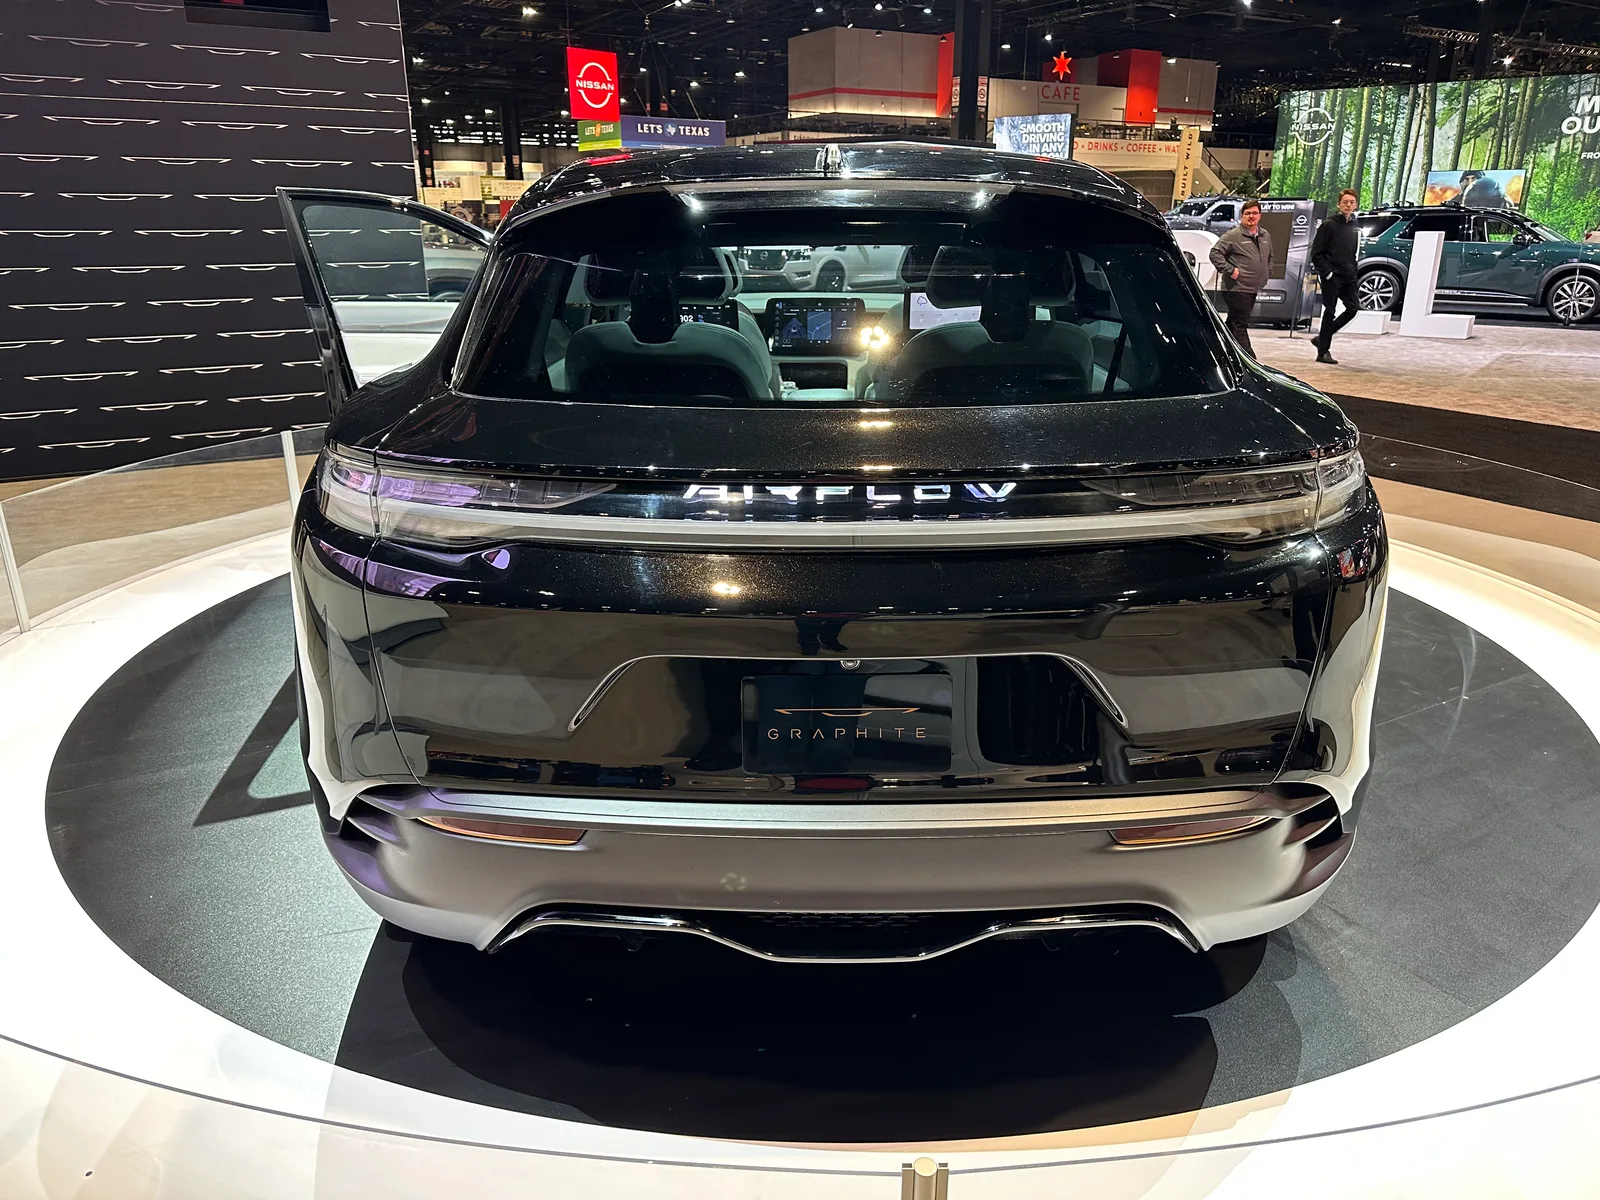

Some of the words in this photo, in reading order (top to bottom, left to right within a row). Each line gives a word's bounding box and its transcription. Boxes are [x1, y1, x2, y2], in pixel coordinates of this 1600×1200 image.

[575, 79, 615, 91] NISSAN
[1041, 84, 1080, 101] CAFE
[601, 123, 614, 134] TEXAS
[637, 123, 663, 134] LET'S
[678, 125, 710, 137] TEXAS
[1020, 122, 1065, 133] SMOOTH
[1291, 122, 1335, 131] NISSAN
[1022, 132, 1065, 143] DRIVING
[1029, 143, 1040, 153] IN
[1041, 142, 1065, 152] ANY
[1087, 141, 1118, 151] DRINKS
[1126, 143, 1157, 153] COFFEE
[1164, 144, 1180, 153] WAT
[1180, 165, 1189, 196] BUILT
[1185, 133, 1193, 160] WILD
[767, 727, 926, 740] GRAPHITE
